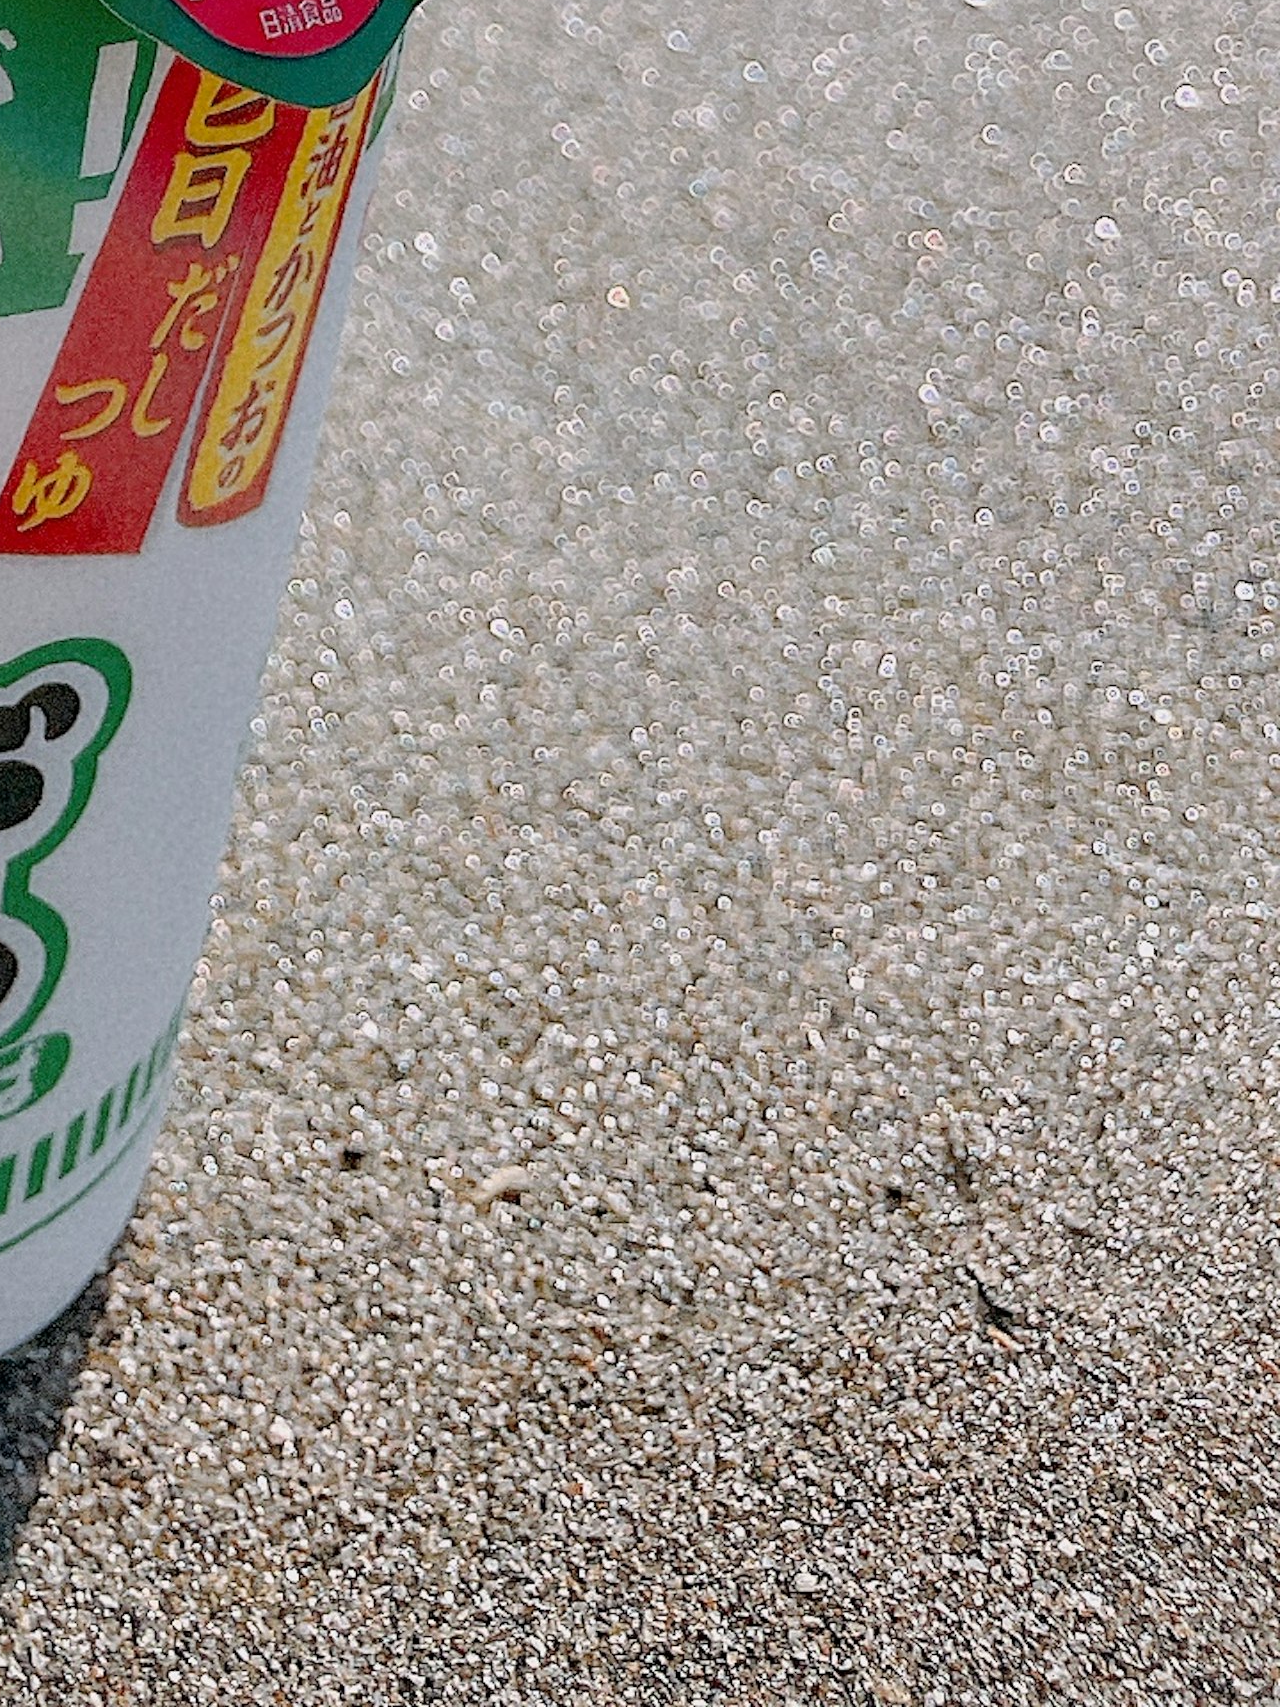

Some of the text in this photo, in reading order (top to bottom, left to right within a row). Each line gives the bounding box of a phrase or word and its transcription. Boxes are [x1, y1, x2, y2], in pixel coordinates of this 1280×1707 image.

[216, 99, 357, 489] 油とかつおの
